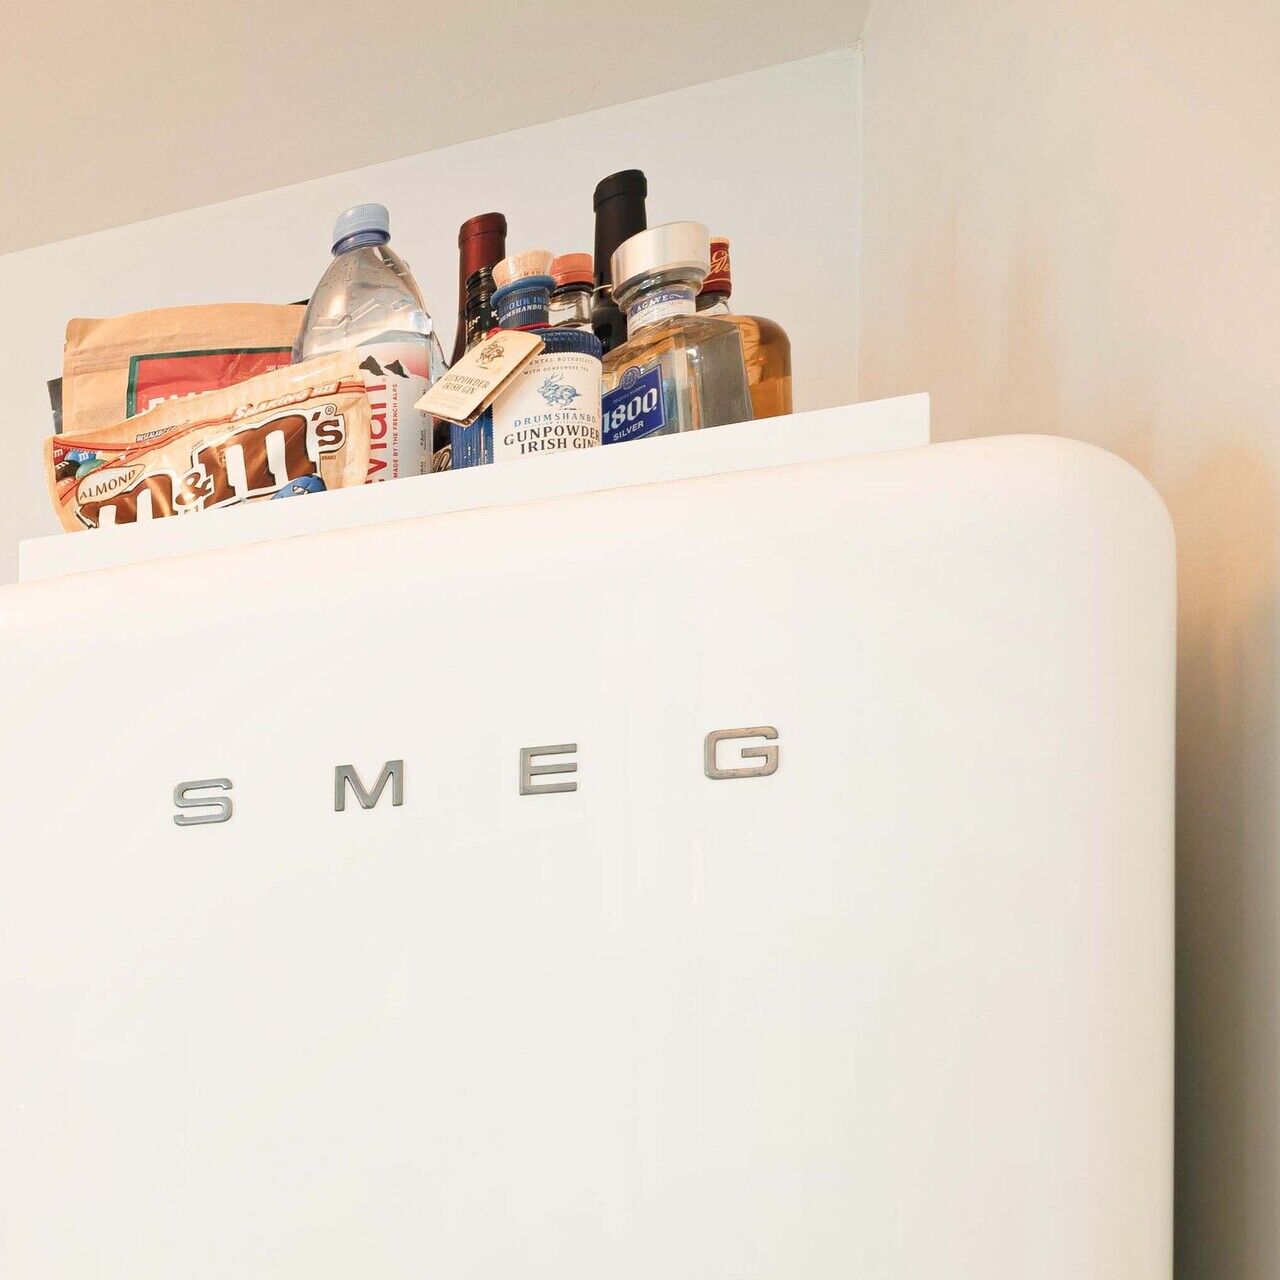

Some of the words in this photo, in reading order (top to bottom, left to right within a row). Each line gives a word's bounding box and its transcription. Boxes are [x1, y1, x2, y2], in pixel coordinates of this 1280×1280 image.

[637, 294, 669, 312] AGAVE
[602, 387, 658, 433] 1800
[514, 412, 597, 428] DRUMSHANBO
[365, 384, 388, 485] vian
[503, 424, 600, 446] GUNPOWDER
[613, 420, 645, 441] SILVER
[392, 447, 399, 456] BY
[520, 437, 567, 455] IRISH
[572, 437, 594, 449] GIN
[78, 452, 90, 462] m
[79, 469, 136, 501] ALMOND
